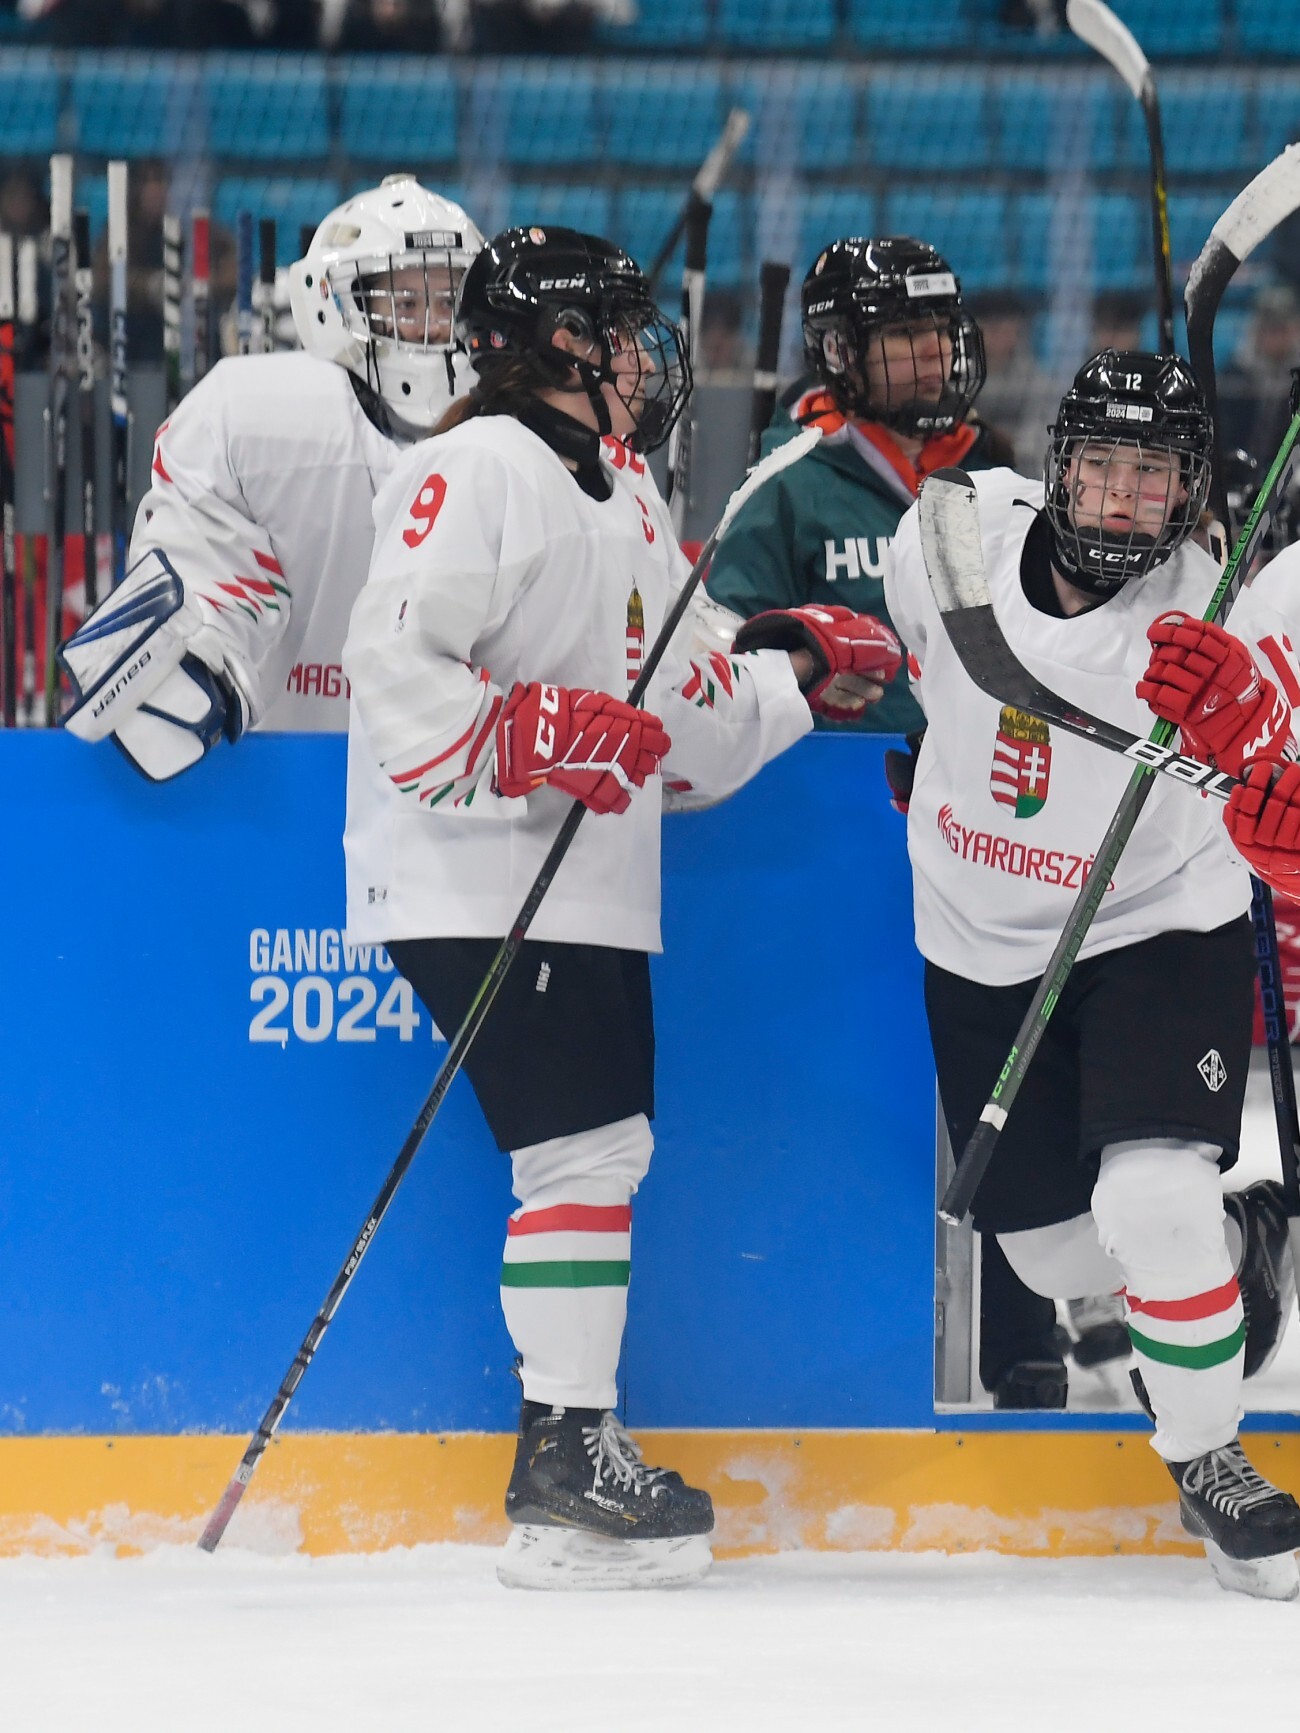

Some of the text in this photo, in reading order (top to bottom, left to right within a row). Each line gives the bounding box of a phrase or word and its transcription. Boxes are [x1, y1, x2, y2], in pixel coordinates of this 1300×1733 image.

[539, 278, 586, 291] CCM
[808, 299, 834, 315] CCM
[1125, 373, 1143, 390] 12
[402, 473, 448, 549] 9
[1089, 549, 1143, 563] CCM
[92, 651, 152, 718] BAUER
[286, 662, 351, 700] MAG
[1124, 738, 1243, 800] BAU
[249, 975, 420, 1044] 2024
[992, 1046, 1018, 1099] CCM
